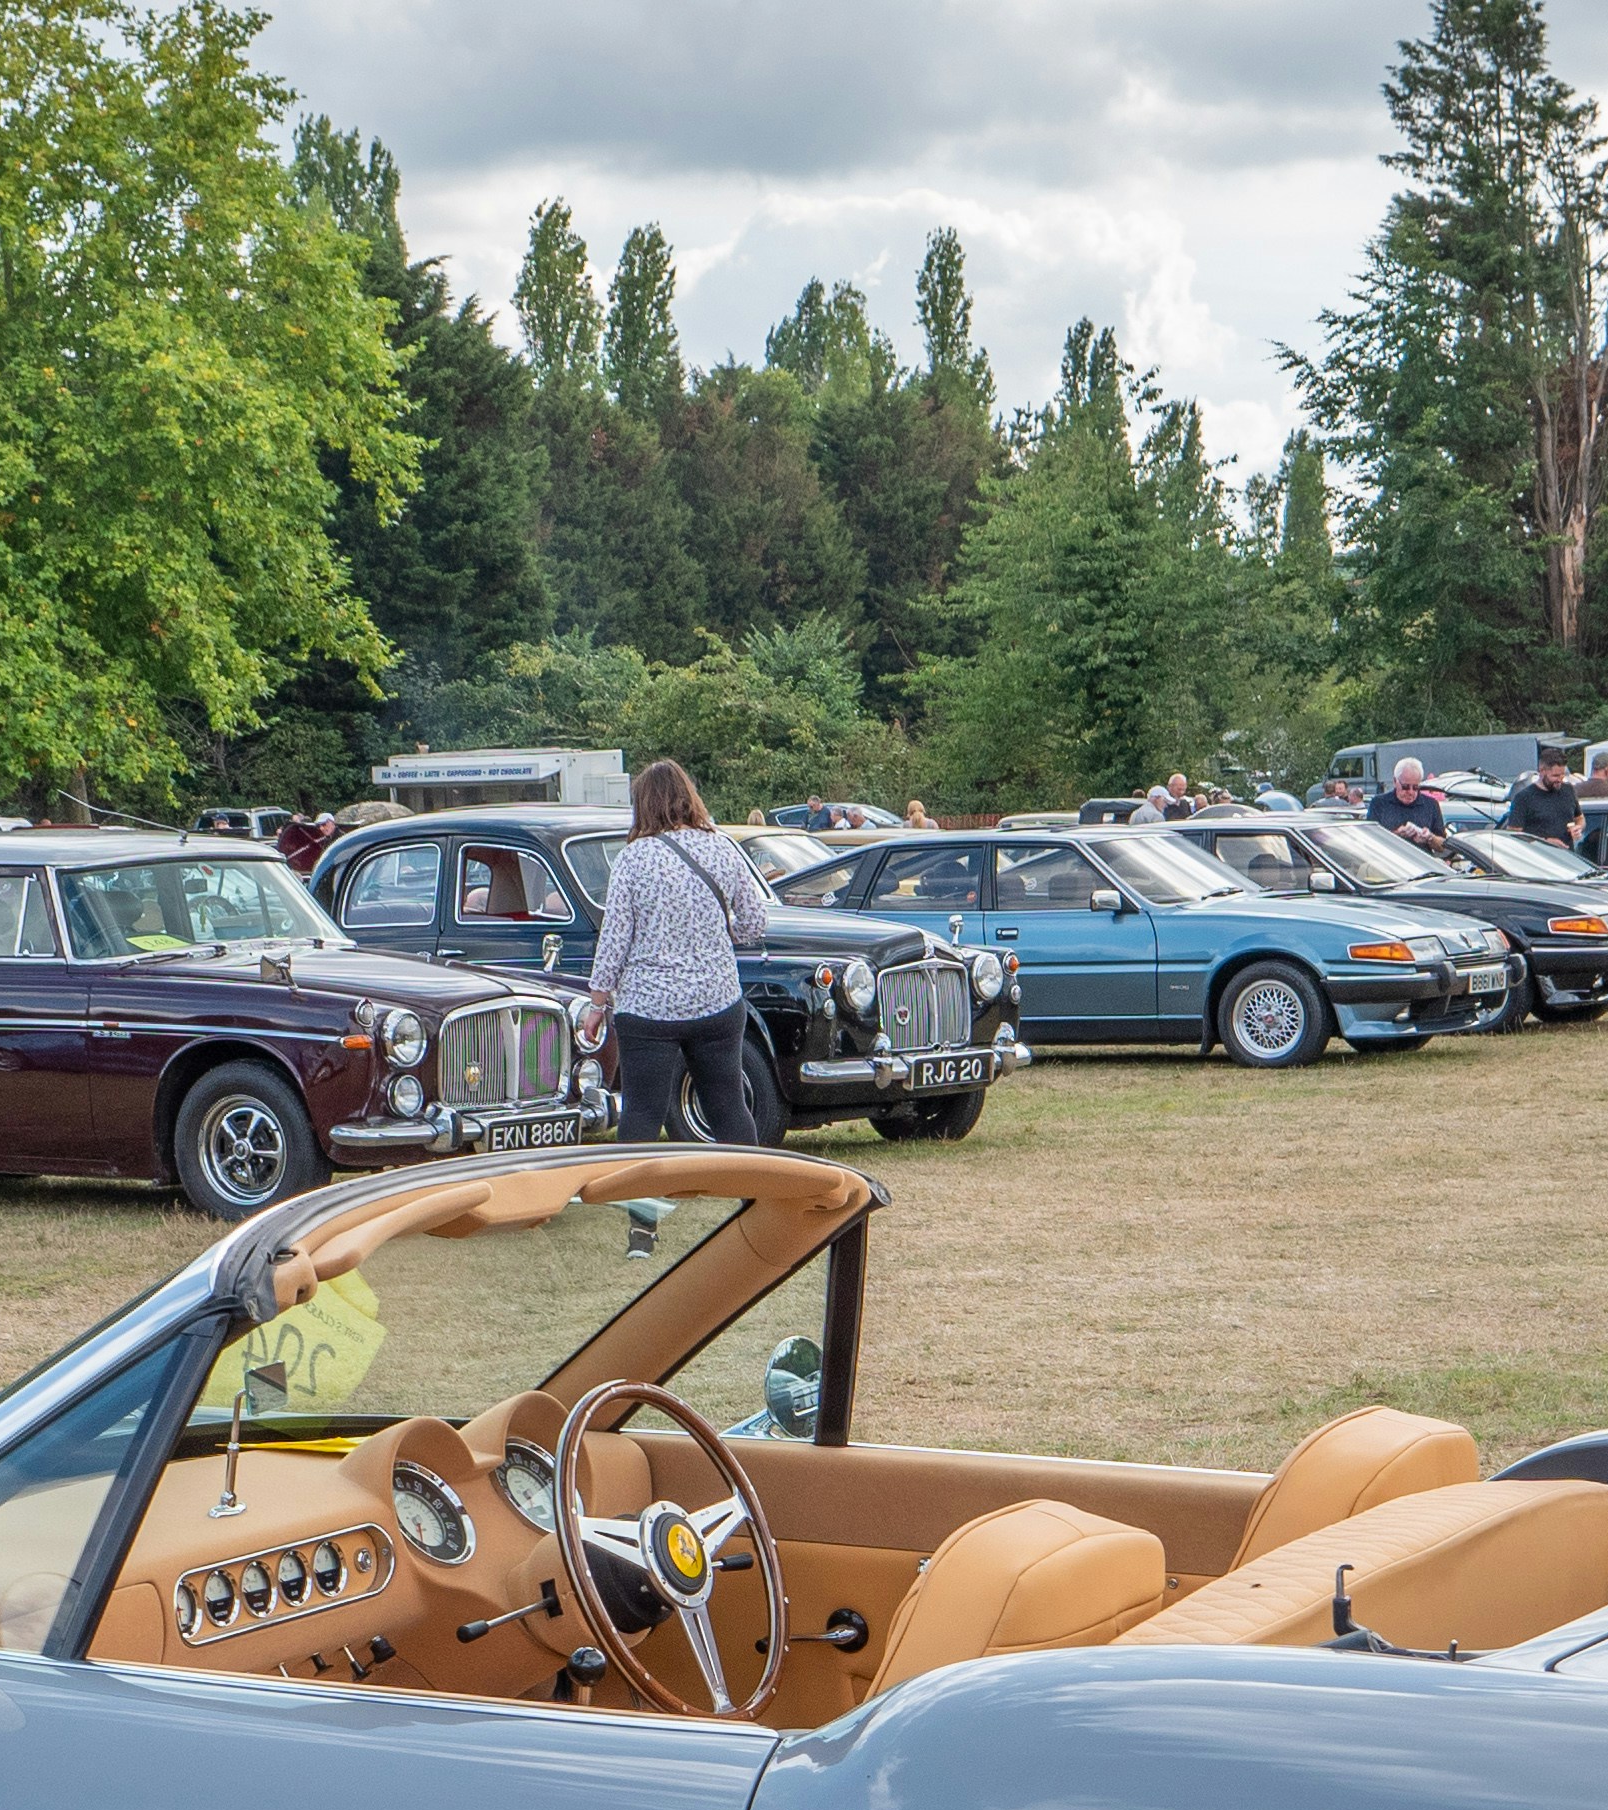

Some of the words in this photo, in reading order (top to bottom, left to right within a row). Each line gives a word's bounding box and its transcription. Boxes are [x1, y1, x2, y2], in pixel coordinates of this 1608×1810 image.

[382, 771, 391, 779] TEA
[397, 770, 418, 779] COFFEE
[424, 770, 440, 778] LATTE
[446, 769, 482, 777] CAPPUCCINO
[488, 768, 500, 776] HOT
[500, 767, 532, 776] CHOCOLATE
[922, 1060, 957, 1085] RJG
[959, 1058, 983, 1081] 20
[492, 1124, 527, 1151] EKN
[530, 1119, 576, 1146] 886K
